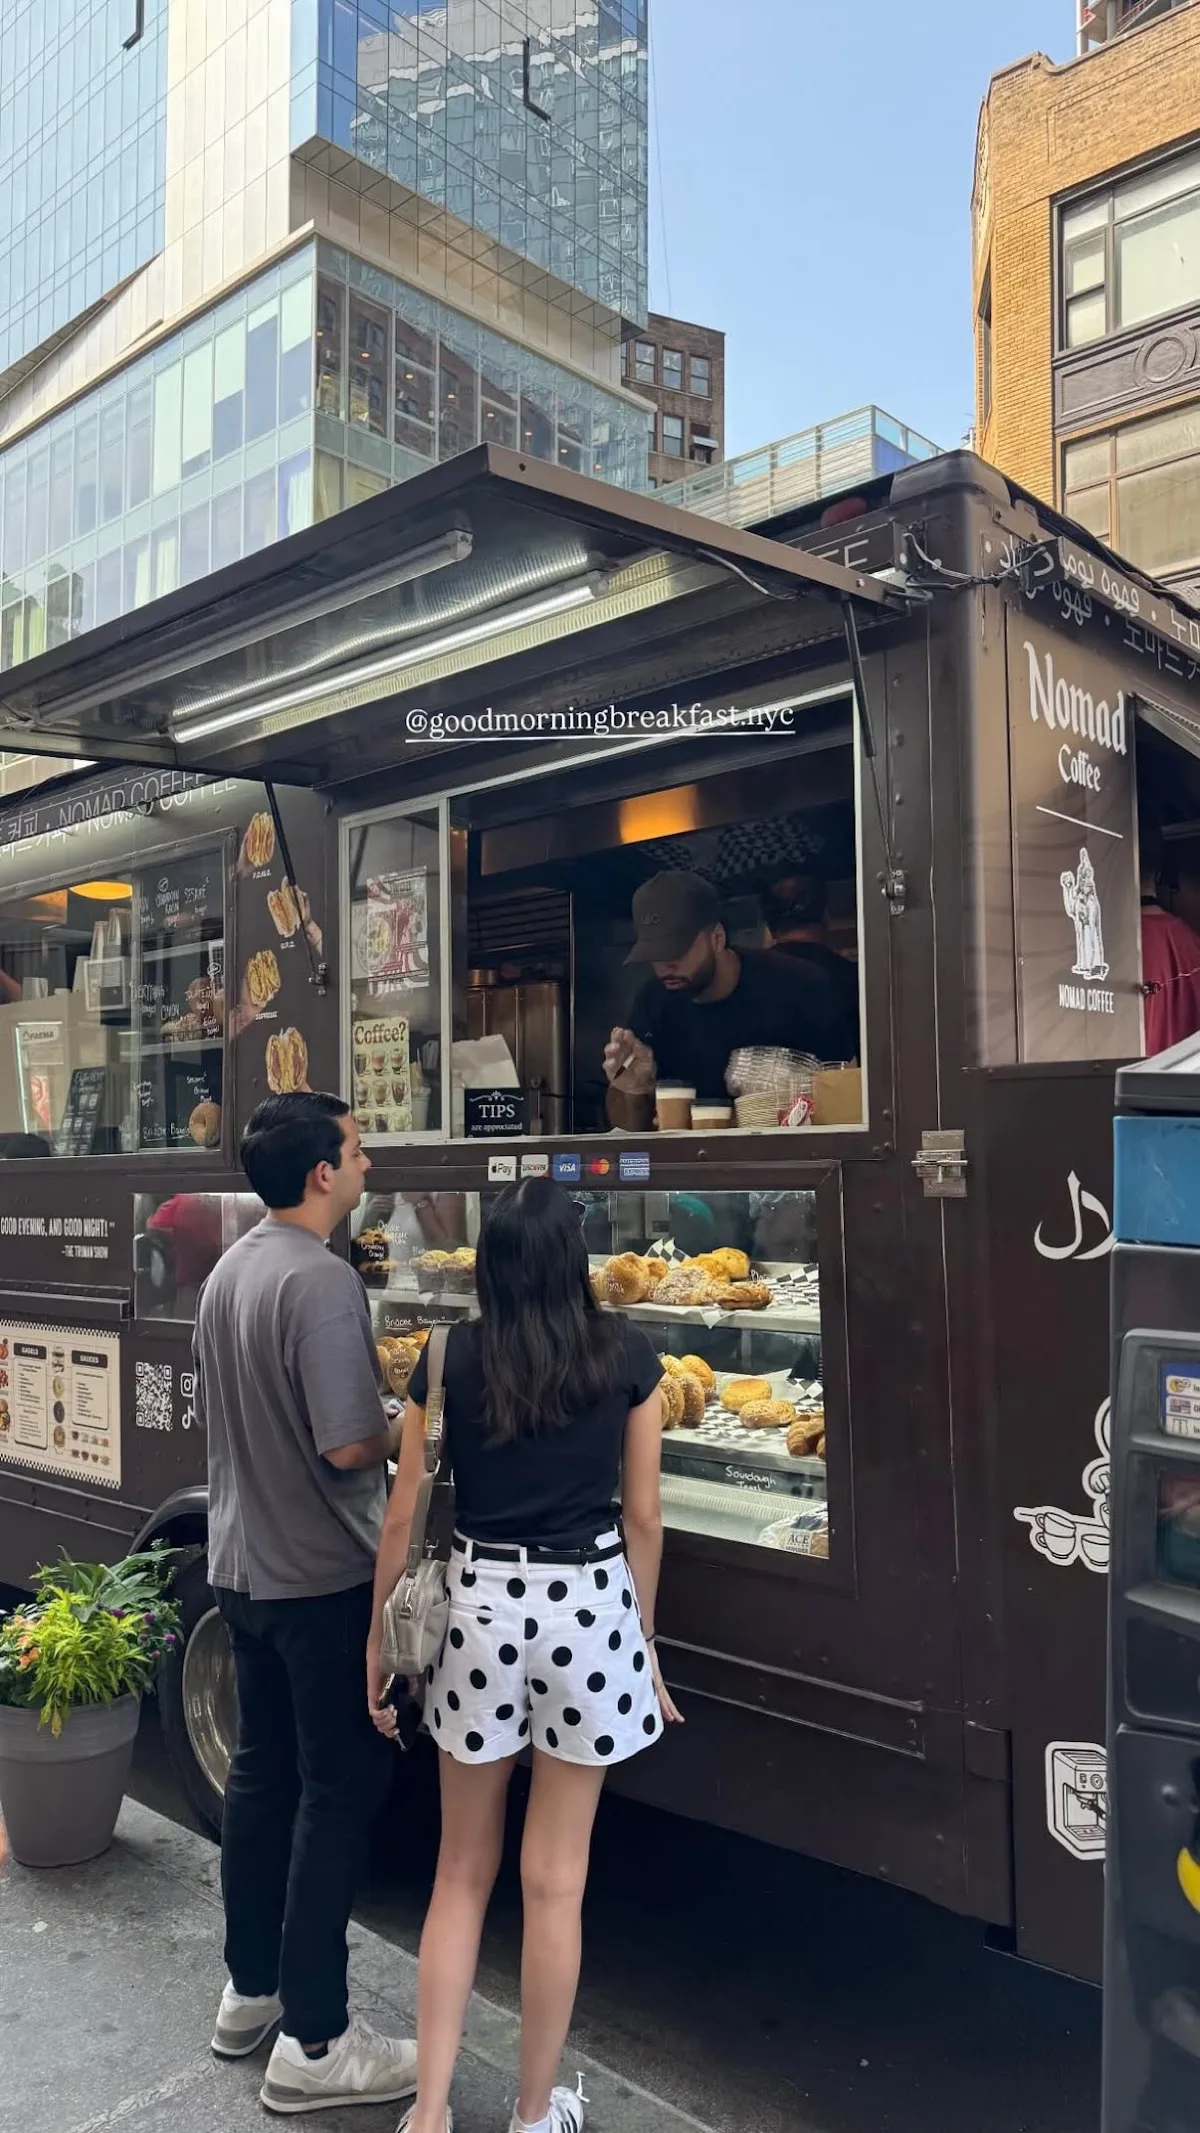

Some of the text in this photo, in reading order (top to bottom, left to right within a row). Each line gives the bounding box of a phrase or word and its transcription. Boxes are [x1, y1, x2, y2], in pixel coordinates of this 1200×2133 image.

[1022, 640, 1128, 757] Nomad
[1058, 743, 1102, 793] Coffee
[1059, 984, 1115, 1014] NOMAD COFFEE
[354, 1021, 407, 1045] Coffee?
[478, 1104, 516, 1119] TIPS
[471, 1122, 483, 1131] are
[497, 1160, 513, 1176] Pay
[559, 1164, 577, 1173] VISA
[0, 1217, 17, 1235] GOOD
[18, 1217, 48, 1237] EVENING,
[48, 1218, 62, 1236] AND
[63, 1218, 83, 1237] GOOD
[725, 1464, 777, 1489] Sourdough
[788, 1534, 810, 1544] ACE
